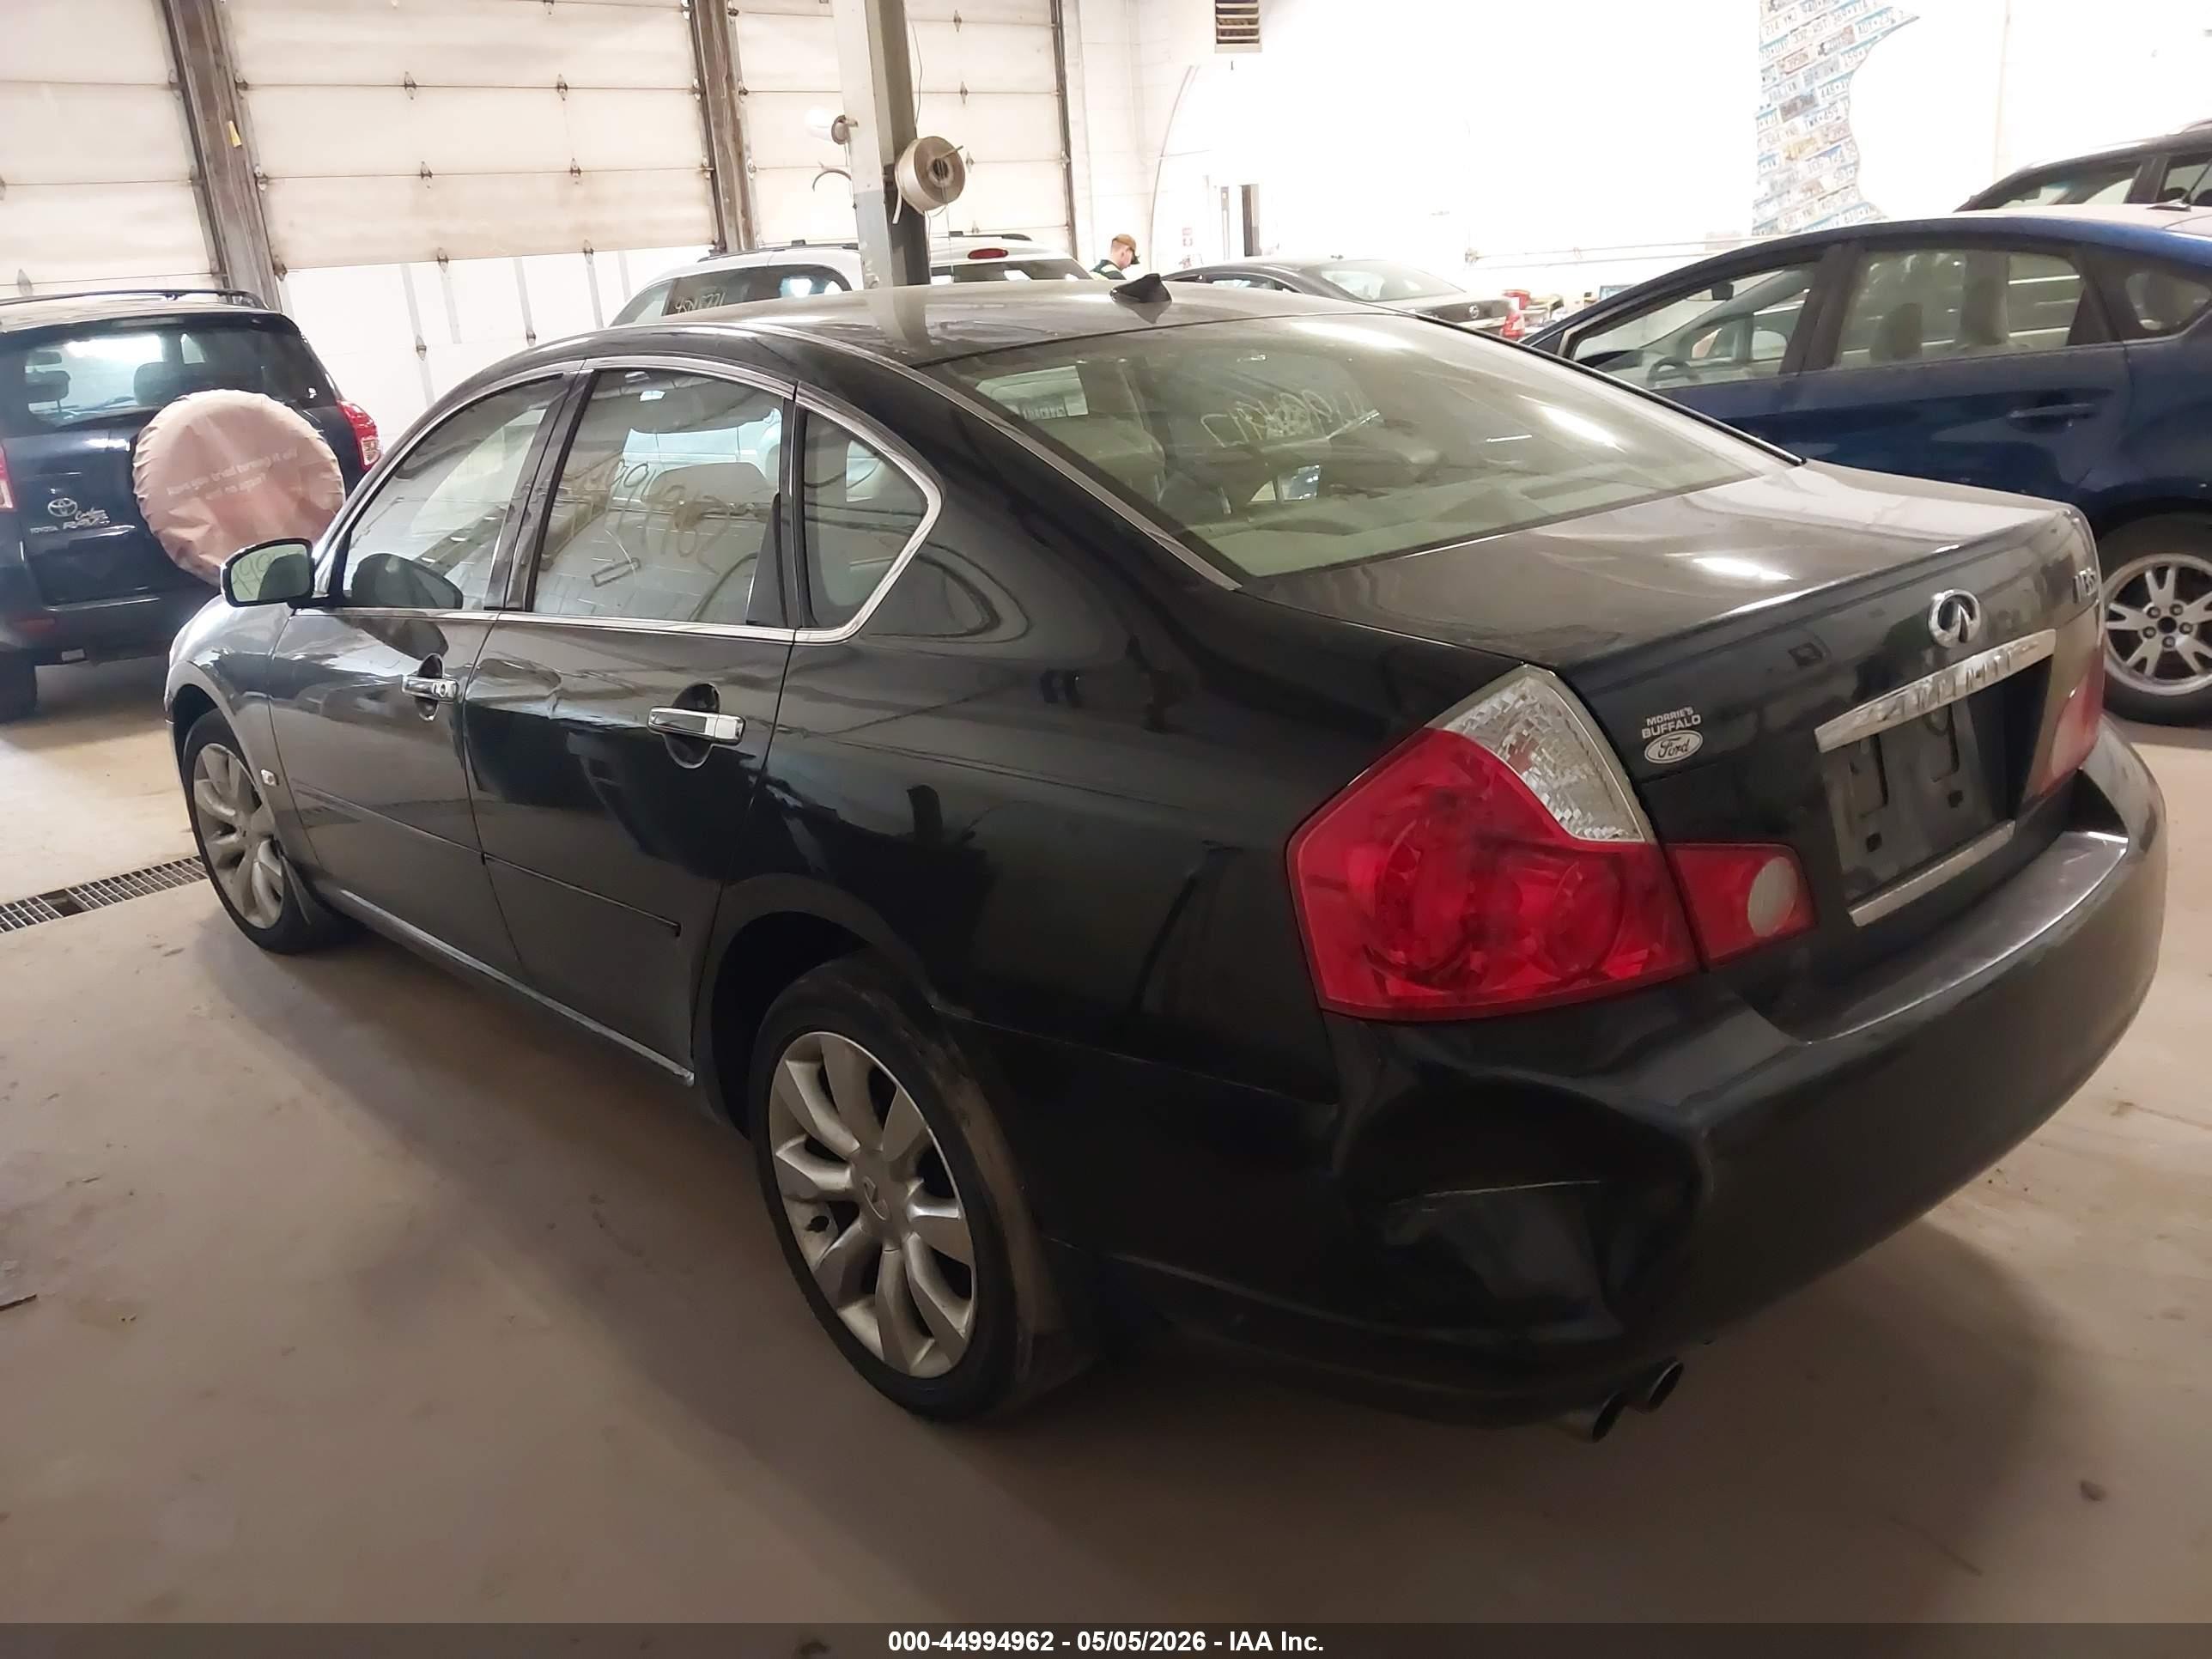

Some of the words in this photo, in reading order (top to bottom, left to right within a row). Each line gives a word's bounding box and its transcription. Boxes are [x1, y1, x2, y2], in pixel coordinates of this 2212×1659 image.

[1641, 714, 1702, 739] BUFFALO
[1646, 706, 1694, 726] MORRIE'S
[1657, 736, 1691, 758] Ford
